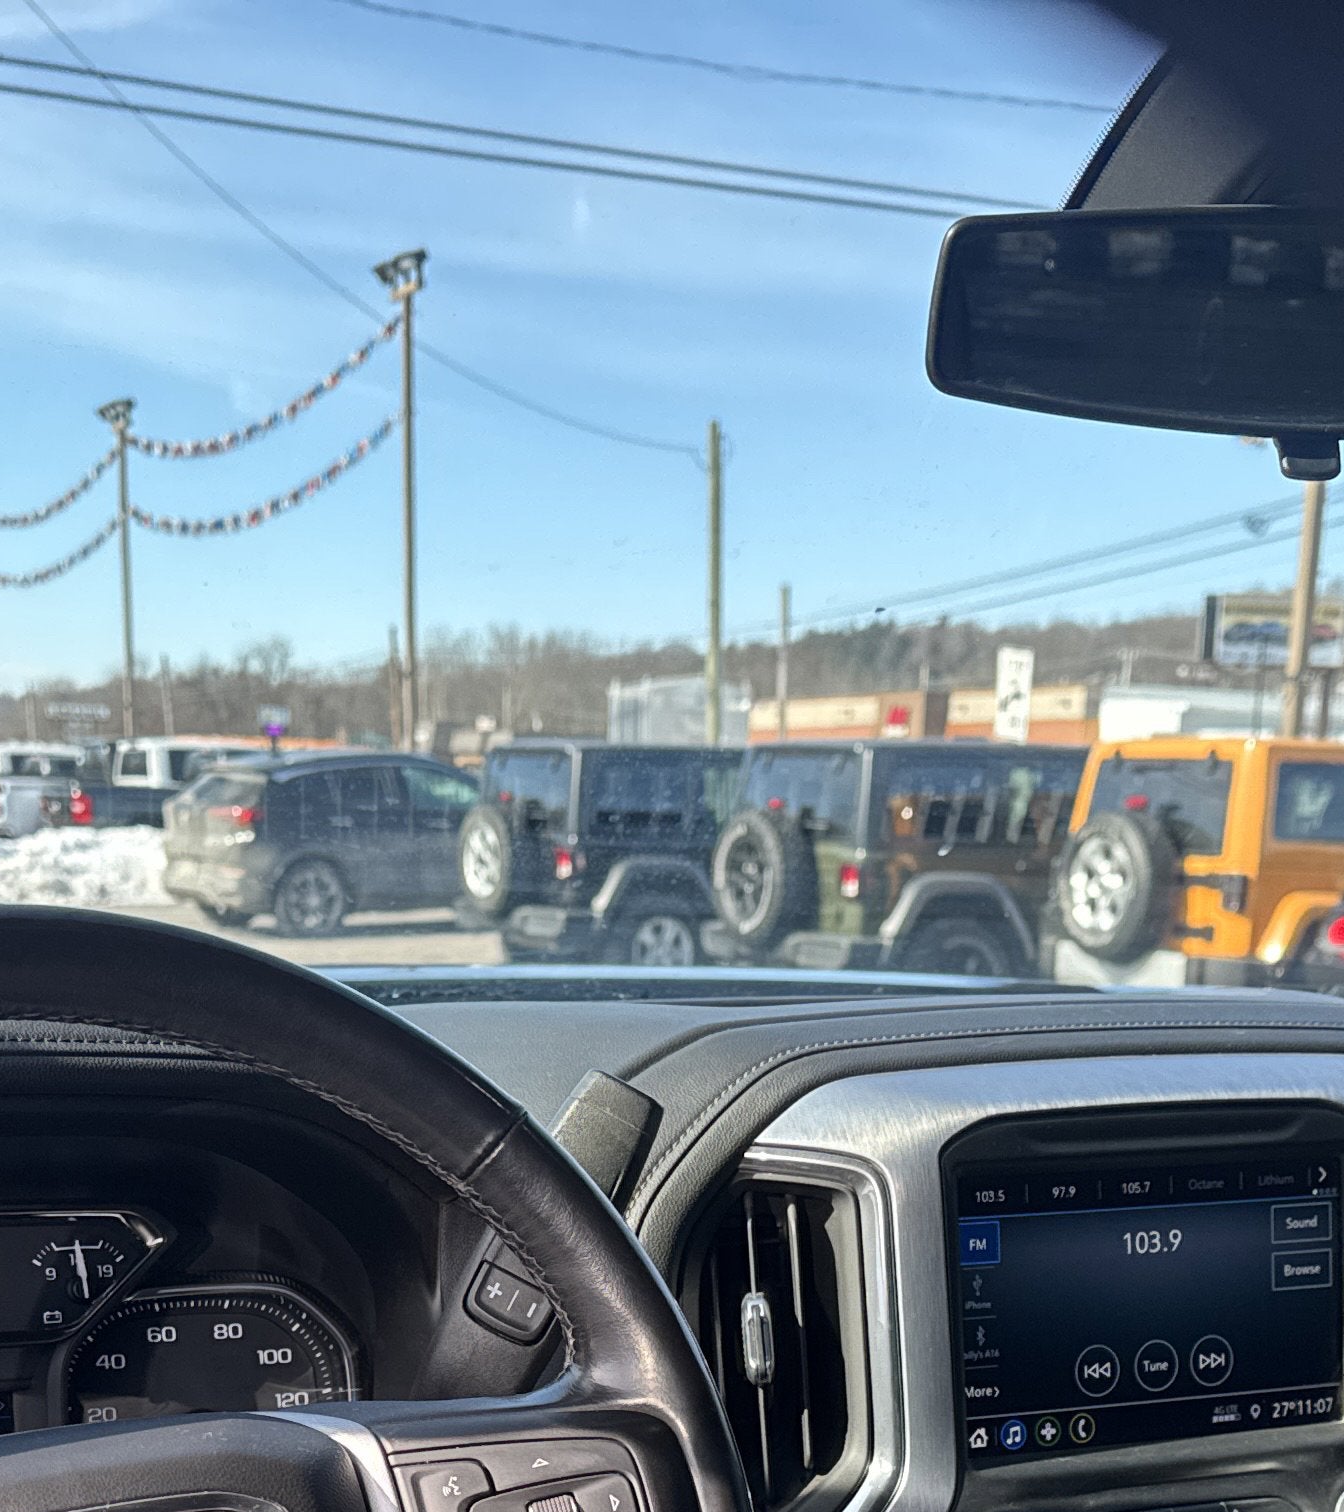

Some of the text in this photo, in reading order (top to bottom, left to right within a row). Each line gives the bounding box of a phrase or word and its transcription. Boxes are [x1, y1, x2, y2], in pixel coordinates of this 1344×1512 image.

[975, 1173, 1295, 1203] 103.5 97.9 105.7 Octane Lithium
[1285, 1214, 1318, 1230] Sound
[969, 1238, 987, 1251] FM
[1123, 1229, 1182, 1255] 103.9
[45, 1267, 57, 1281] 9
[96, 1264, 114, 1278] 19
[1283, 1263, 1322, 1277] Browse
[147, 1326, 177, 1343] 60
[213, 1323, 243, 1340] 80
[95, 1354, 126, 1370] 40
[257, 1348, 293, 1365] 100
[1143, 1360, 1169, 1372] Tune
[275, 1391, 309, 1408] 120
[964, 1386, 993, 1399] More
[88, 1406, 117, 1423] 20
[1297, 1397, 1334, 1416] 11:07
